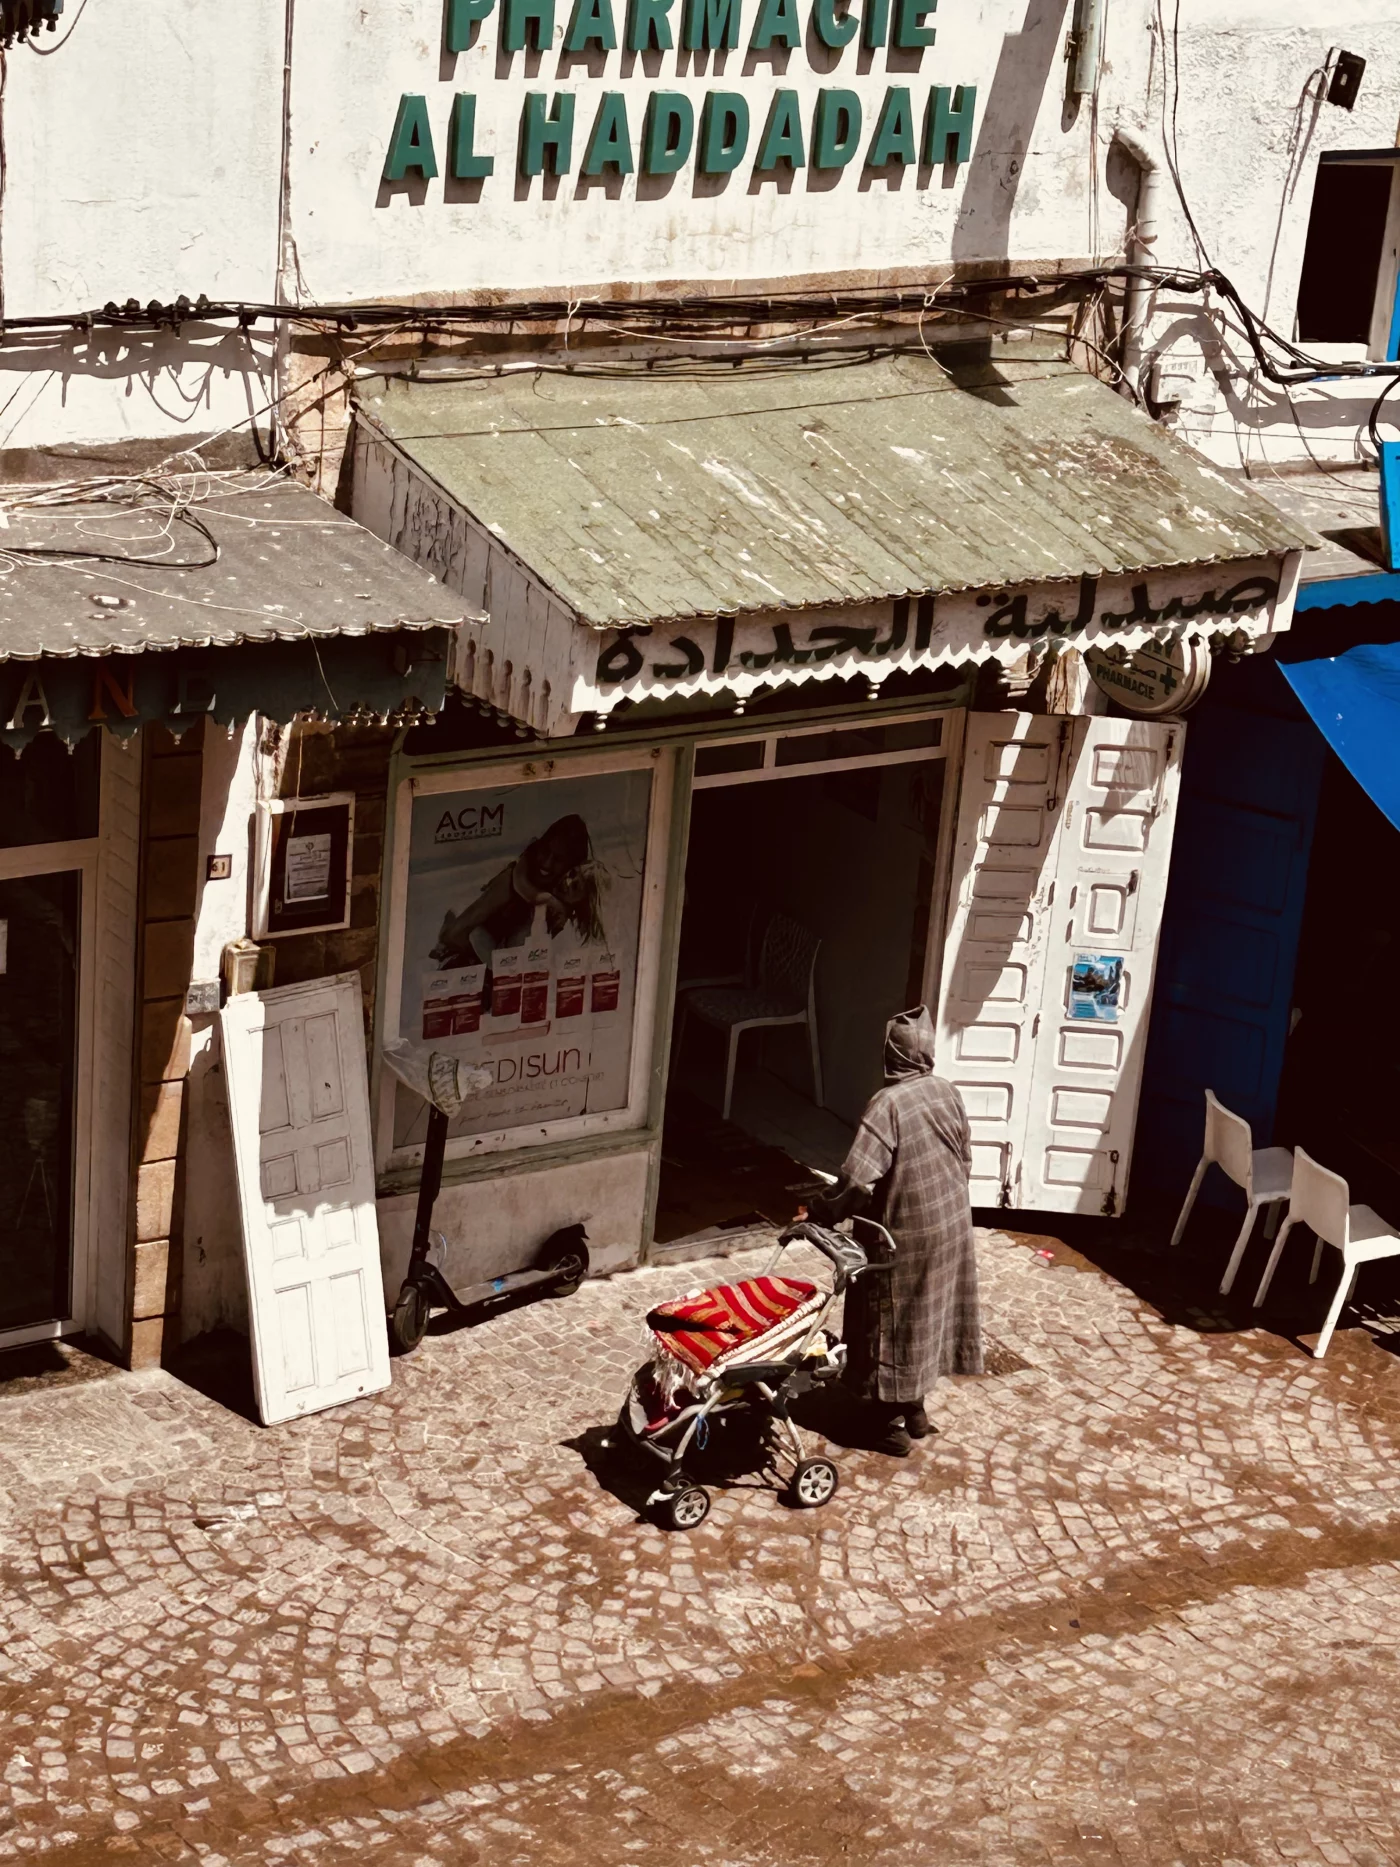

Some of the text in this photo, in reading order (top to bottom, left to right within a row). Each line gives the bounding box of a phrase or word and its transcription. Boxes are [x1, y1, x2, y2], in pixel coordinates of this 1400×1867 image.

[447, 0, 937, 53] PHARMACIE
[383, 84, 977, 178] AL HADDADAH
[1096, 663, 1156, 700] PHARMACIE
[436, 803, 505, 833] ACM
